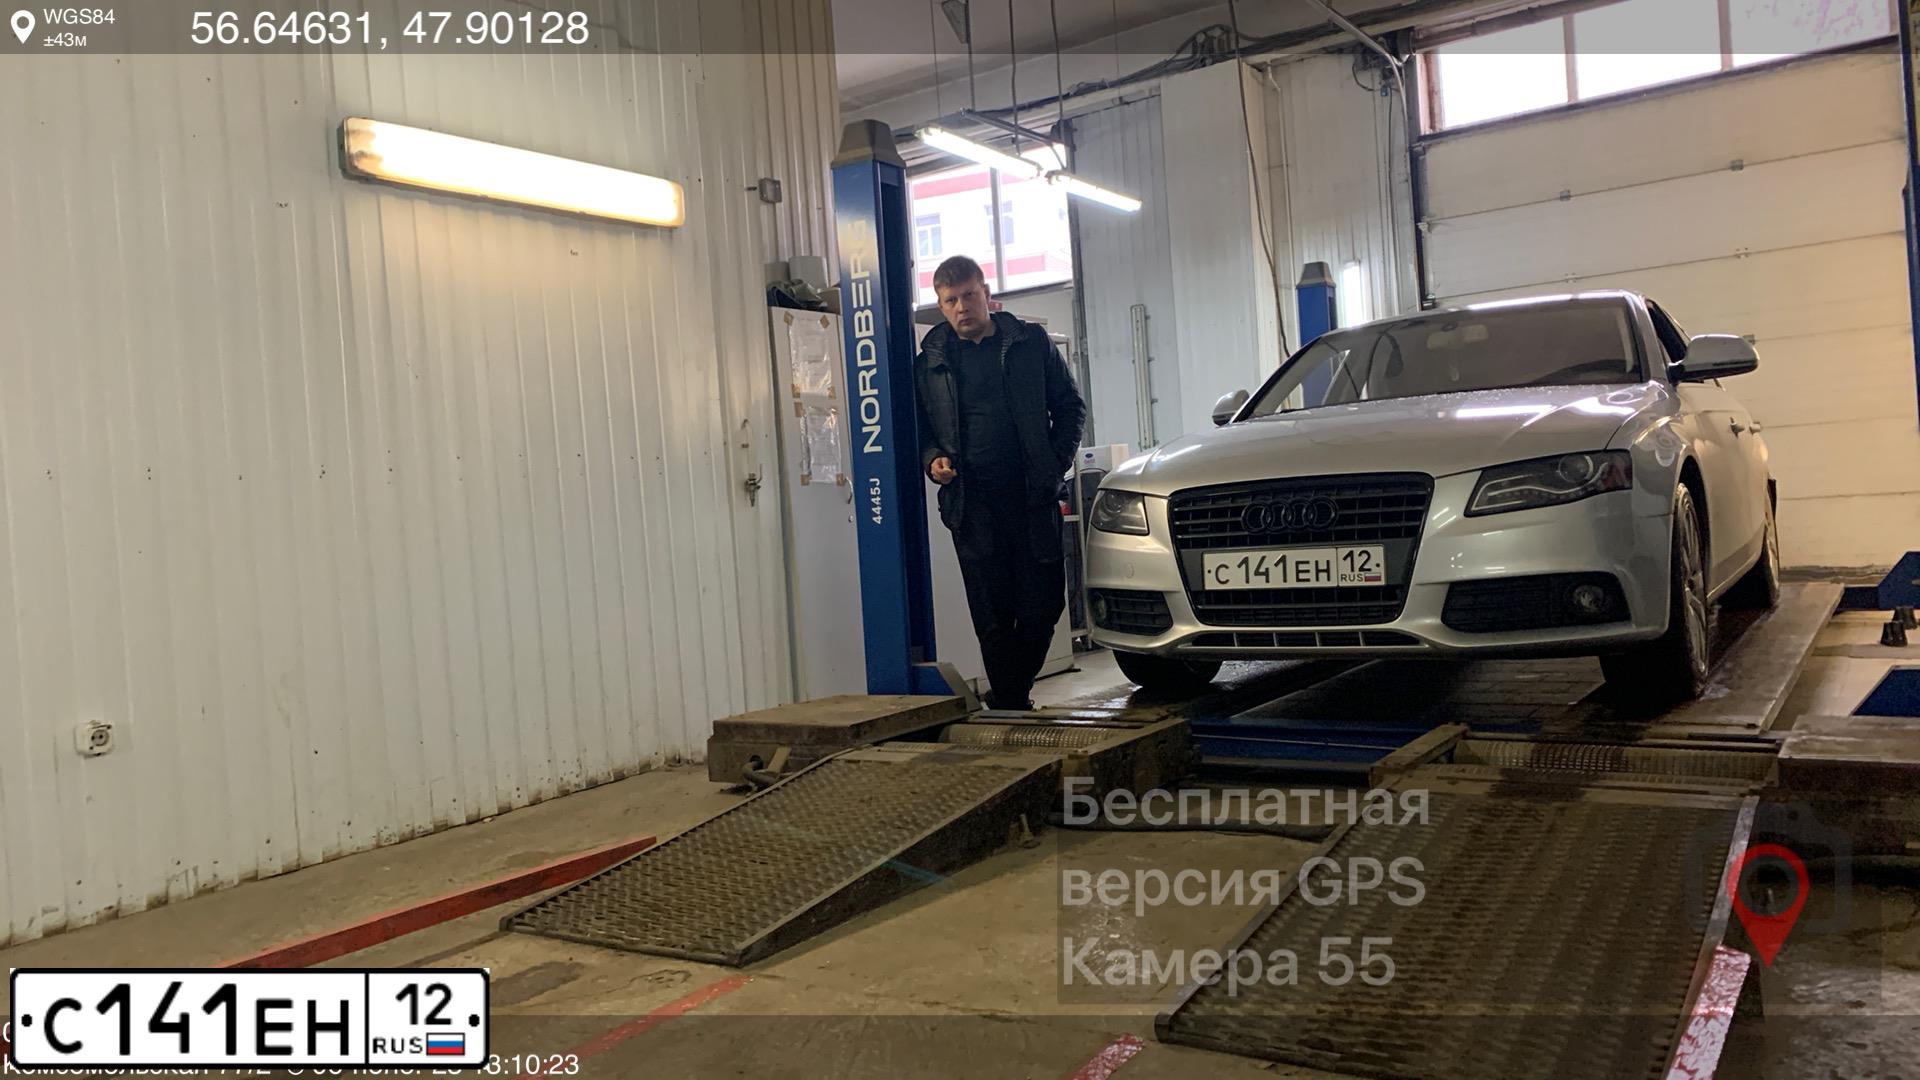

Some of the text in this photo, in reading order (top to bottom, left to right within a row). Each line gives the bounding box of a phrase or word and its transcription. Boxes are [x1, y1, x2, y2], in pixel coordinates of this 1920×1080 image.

[869, 478, 882, 524] 4445J
[1215, 549, 1373, 585] С141ЕН 12
[1340, 573, 1364, 583] RUS
